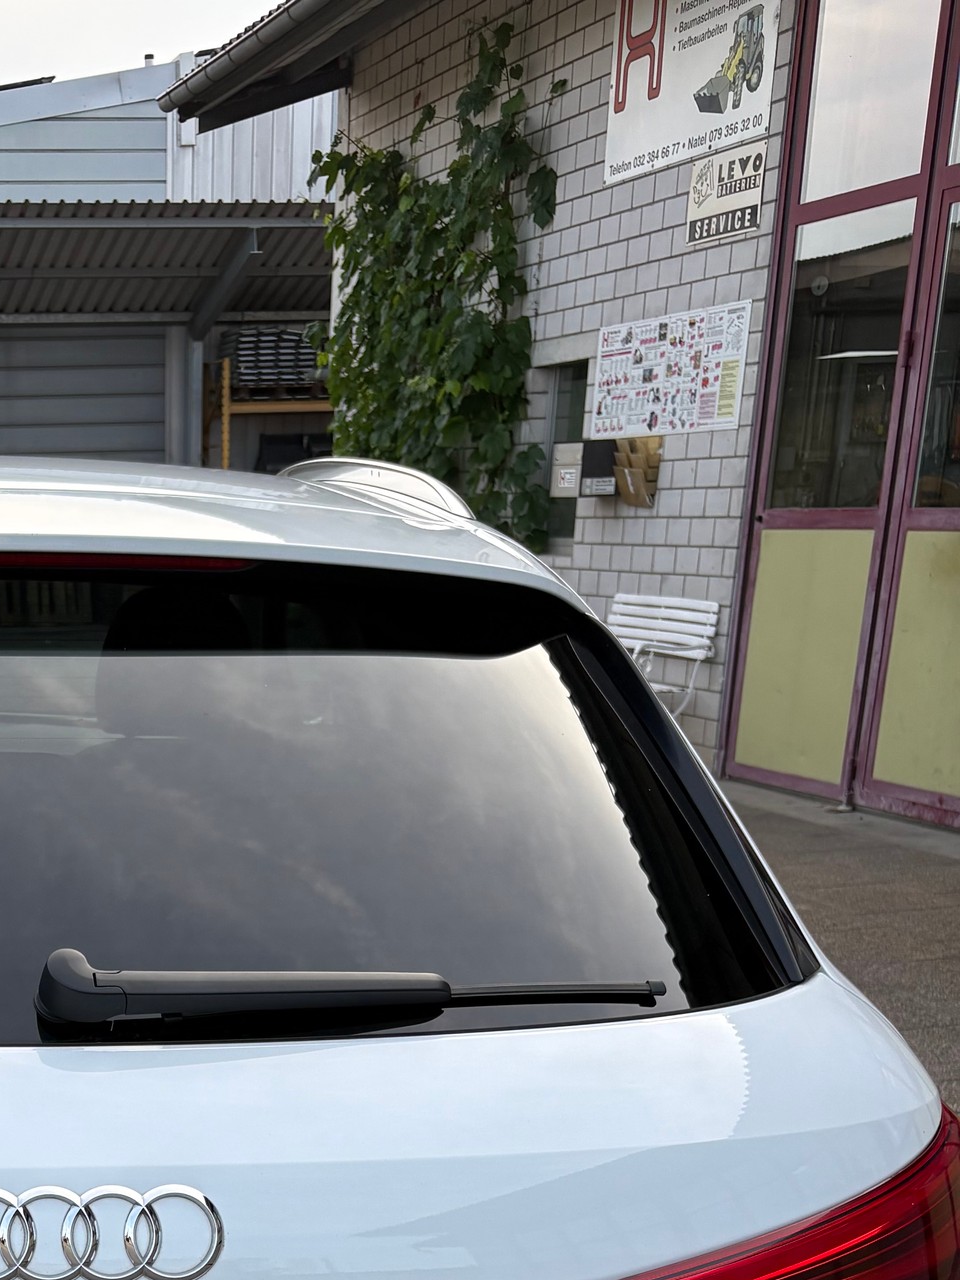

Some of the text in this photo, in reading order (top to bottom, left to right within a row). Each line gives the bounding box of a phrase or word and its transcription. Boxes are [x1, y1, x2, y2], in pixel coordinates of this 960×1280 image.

[678, 22, 728, 51] Tiefbauarbeiten
[609, 160, 632, 177] Telefon
[633, 153, 646, 169] 032
[661, 145, 670, 159] 66
[672, 142, 681, 156] 77
[687, 131, 708, 150] Natel
[709, 127, 723, 143] 079
[724, 121, 739, 138] 356
[740, 117, 751, 132] 32
[752, 113, 763, 128] 00
[717, 152, 763, 184] LEVO
[694, 208, 752, 239] SERVICE
